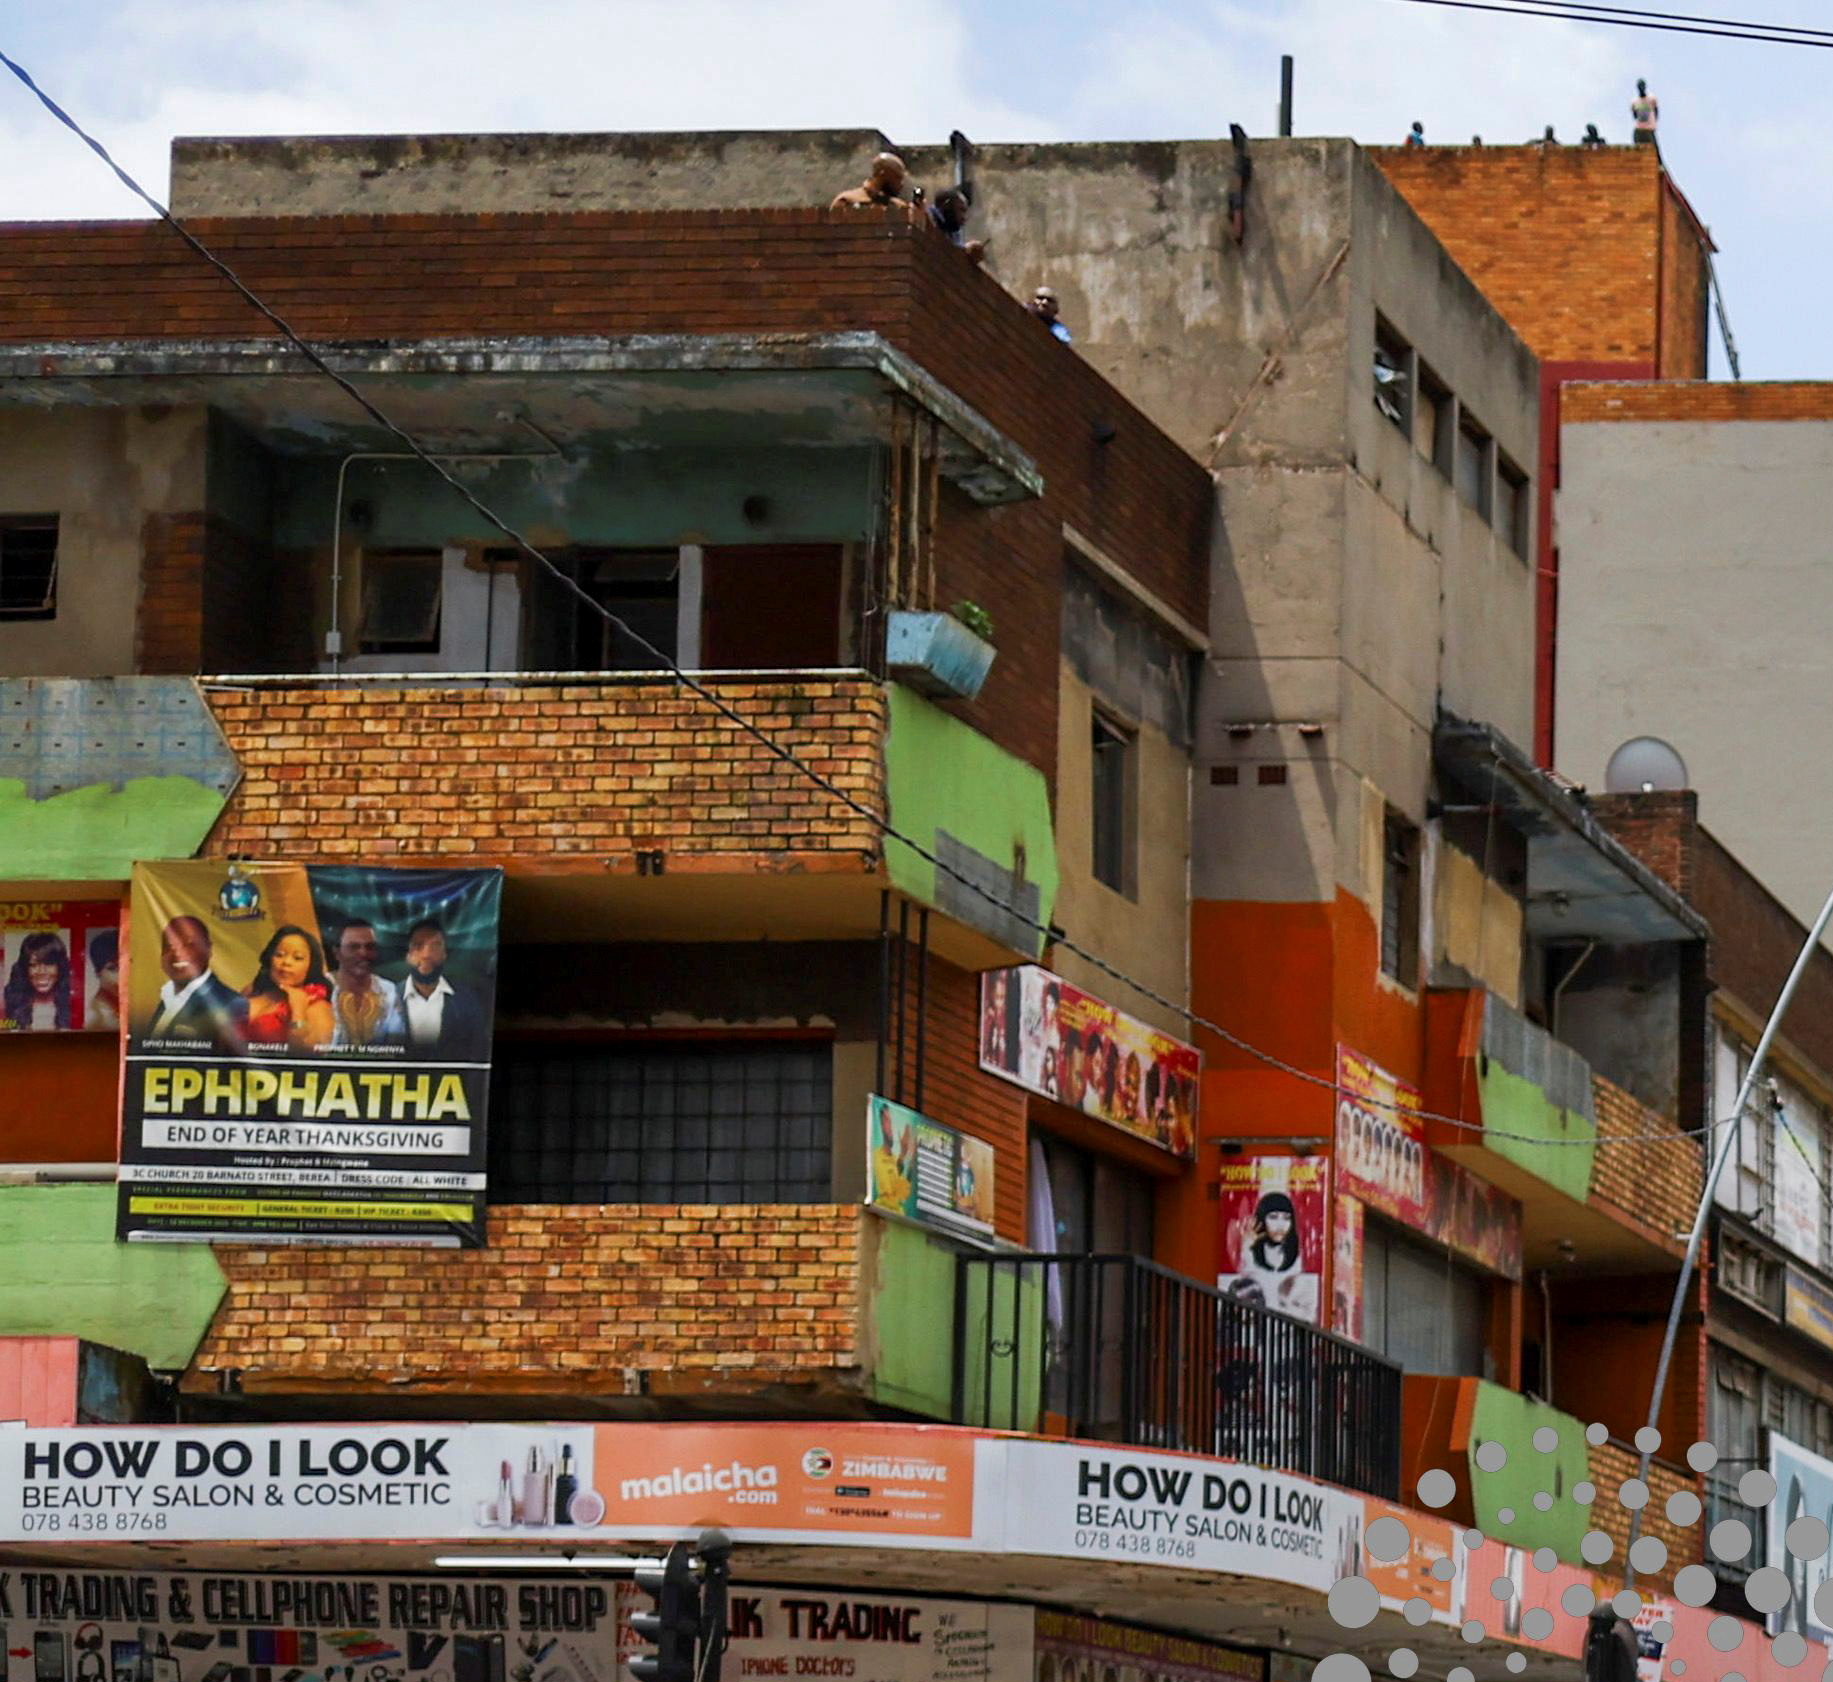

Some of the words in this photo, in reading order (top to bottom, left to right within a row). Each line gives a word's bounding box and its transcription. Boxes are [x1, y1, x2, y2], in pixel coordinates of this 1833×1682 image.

[143, 1067, 471, 1121] EPHPHATHA
[167, 1126, 206, 1142] END
[212, 1127, 238, 1143] OF
[243, 1127, 291, 1144] YEAR
[295, 1129, 444, 1148] THANKSGIVING
[132, 1169, 146, 1180] 3C
[147, 1169, 189, 1180] CHURCH
[192, 1170, 204, 1180] 20
[207, 1170, 255, 1182] BARNATO
[342, 1174, 372, 1185] DRESS
[375, 1175, 404, 1185] CODE
[413, 1176, 430, 1186] ALL
[433, 1176, 468, 1186] WHITE
[24, 1440, 160, 1479] HOW
[175, 1440, 252, 1478] DO
[269, 1440, 281, 1477] I
[299, 1438, 450, 1478] LOOK
[842, 1461, 947, 1482] ZIMBABWE
[22, 1485, 146, 1508] BEAUTY
[152, 1484, 253, 1507] SALON
[265, 1484, 284, 1506] &
[294, 1482, 451, 1506] COSMETIC
[620, 1460, 778, 1502] malaicha
[728, 1490, 778, 1506] .com
[1078, 1458, 1193, 1507] HOW
[1203, 1476, 1252, 1516] DO
[1259, 1483, 1267, 1518] I
[1274, 1489, 1324, 1534] LOOK
[22, 1512, 60, 1531] 078
[68, 1513, 108, 1530] 438
[115, 1513, 167, 1530] 8768
[1076, 1503, 1180, 1533] BEAUTY
[1185, 1516, 1252, 1543] SALON
[1255, 1528, 1267, 1545] &
[1270, 1528, 1324, 1560] COSMETIC
[1075, 1530, 1110, 1550] 078
[1115, 1533, 1151, 1554] 438
[1157, 1538, 1196, 1558] 8768
[21, 1573, 159, 1621] TRADING
[168, 1576, 195, 1623] &
[202, 1578, 380, 1628] CELLPHONE
[388, 1582, 510, 1632] REPAIR
[518, 1585, 608, 1632] SHOP
[779, 1598, 922, 1644] TRADING
[741, 1656, 790, 1677] IPHONE
